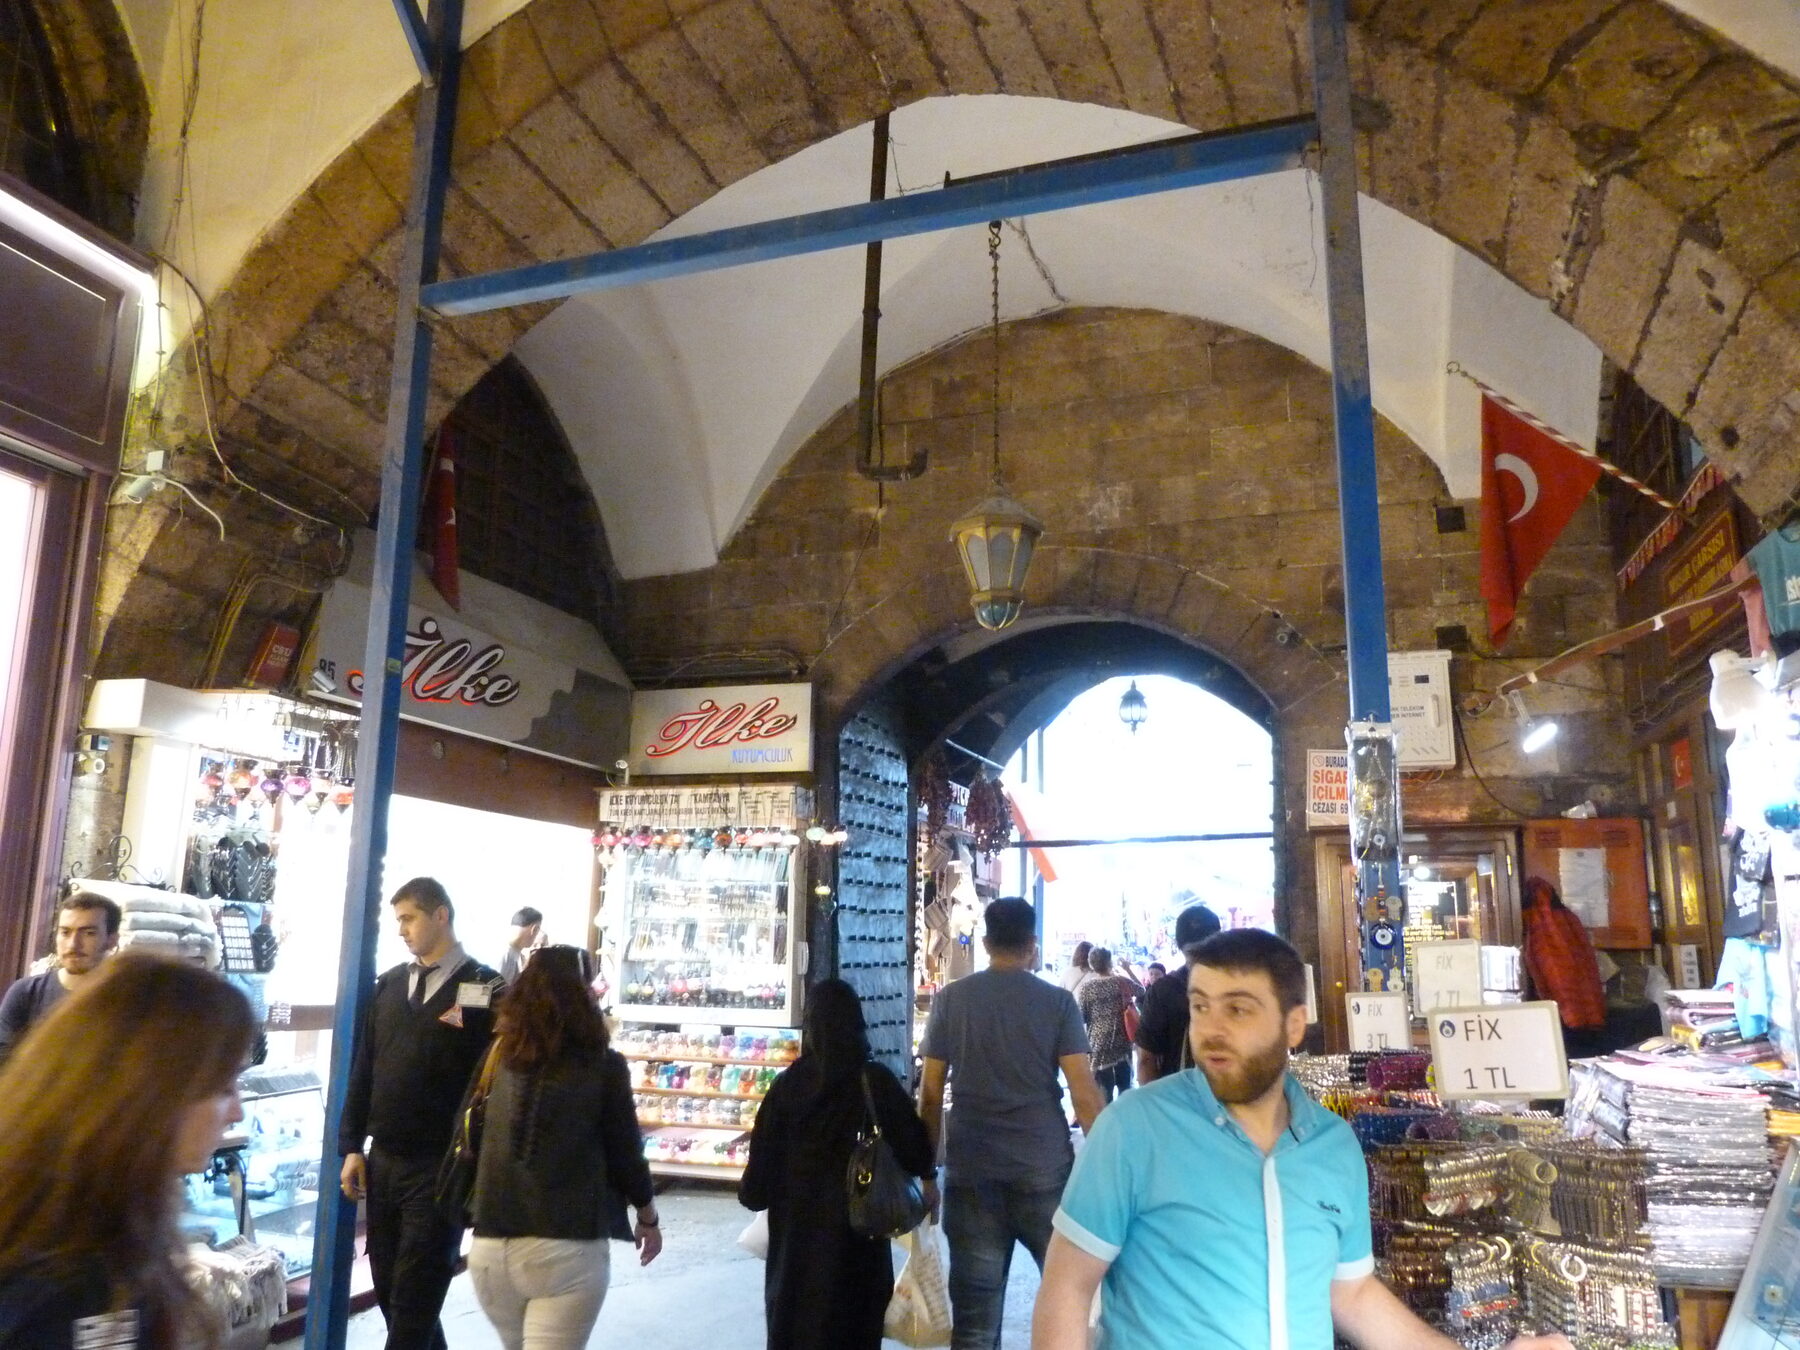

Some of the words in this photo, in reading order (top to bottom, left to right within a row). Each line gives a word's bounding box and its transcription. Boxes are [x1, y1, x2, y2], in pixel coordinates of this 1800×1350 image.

[646, 697, 798, 758] İlke
[732, 748, 793, 763] KUYUMCULUK
[1325, 756, 1348, 768] BURADA
[1312, 802, 1337, 814] CEZASI
[1367, 1001, 1383, 1017] FİX
[1464, 1014, 1502, 1041] FİX
[1367, 1033, 1373, 1049] 3
[1464, 1068, 1478, 1089] 1
[1484, 1067, 1516, 1089] TL
